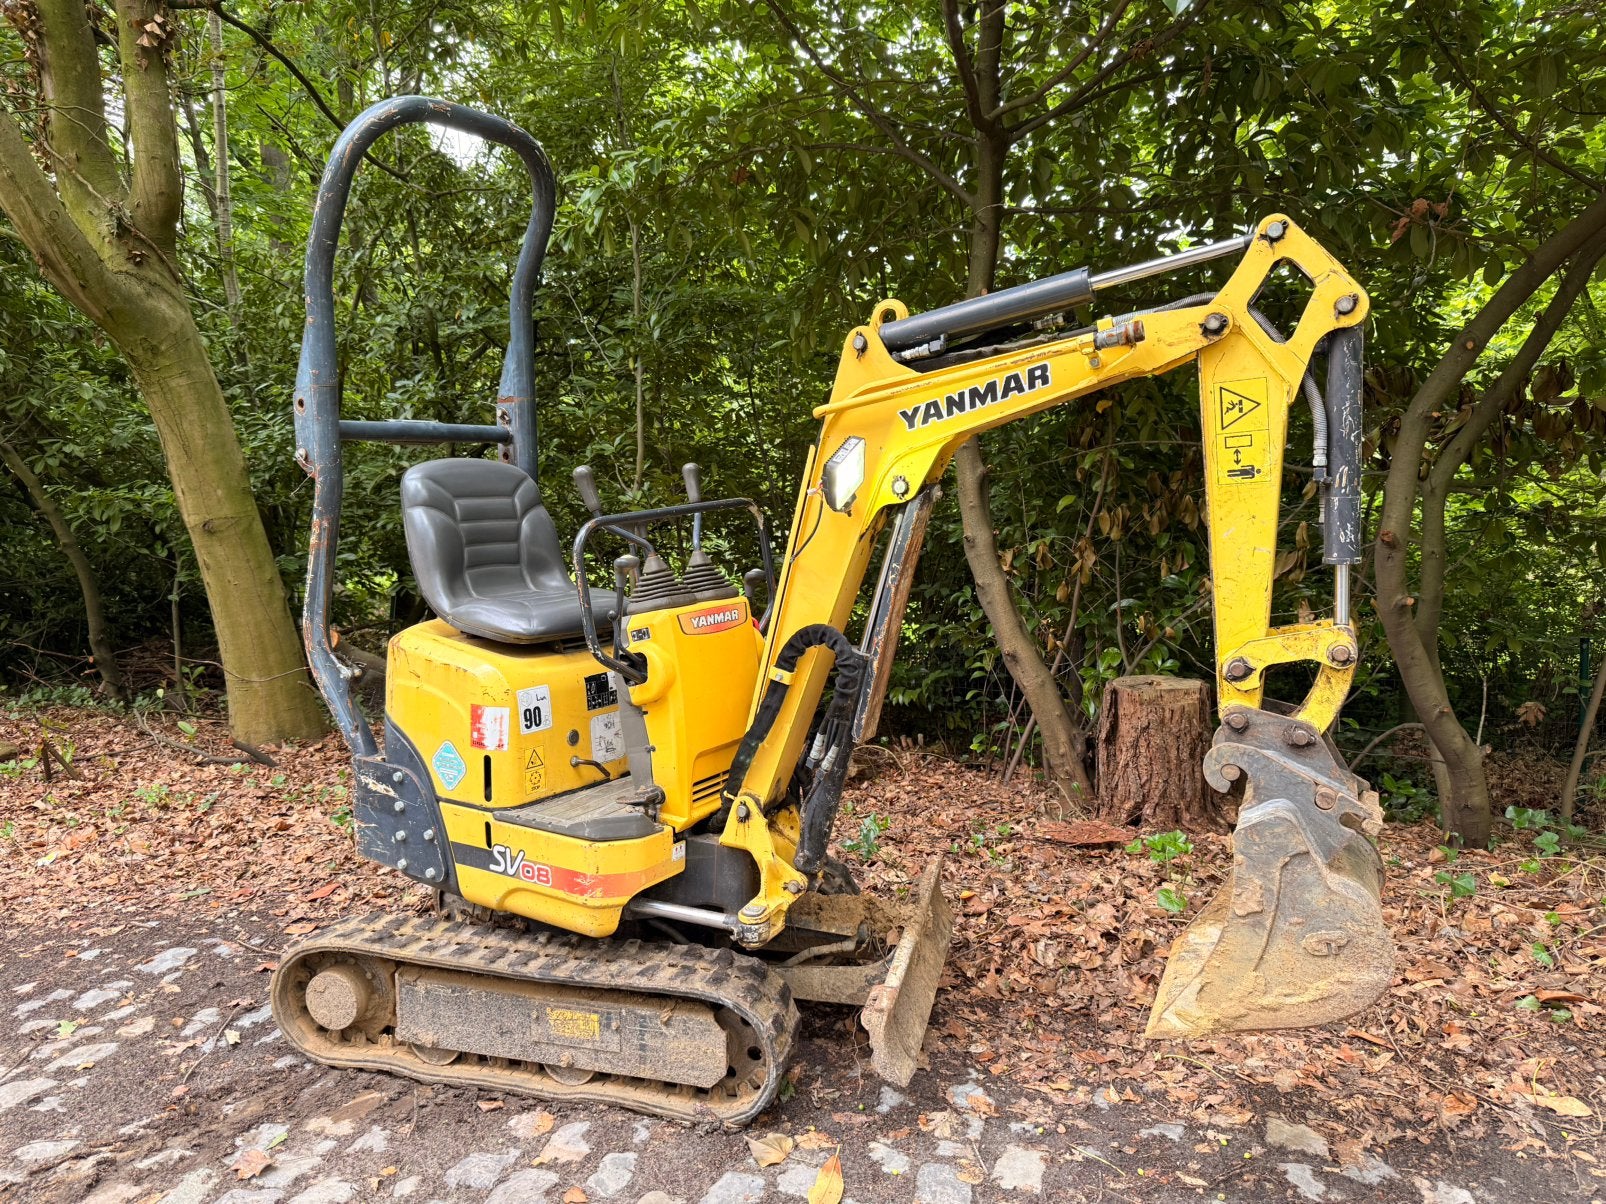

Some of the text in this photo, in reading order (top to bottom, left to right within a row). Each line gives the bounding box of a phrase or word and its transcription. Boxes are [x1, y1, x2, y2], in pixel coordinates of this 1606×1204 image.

[899, 362, 1051, 431] YANMAR
[690, 609, 739, 629] YANMAR
[523, 706, 542, 730] 90
[489, 845, 552, 887] SV08
